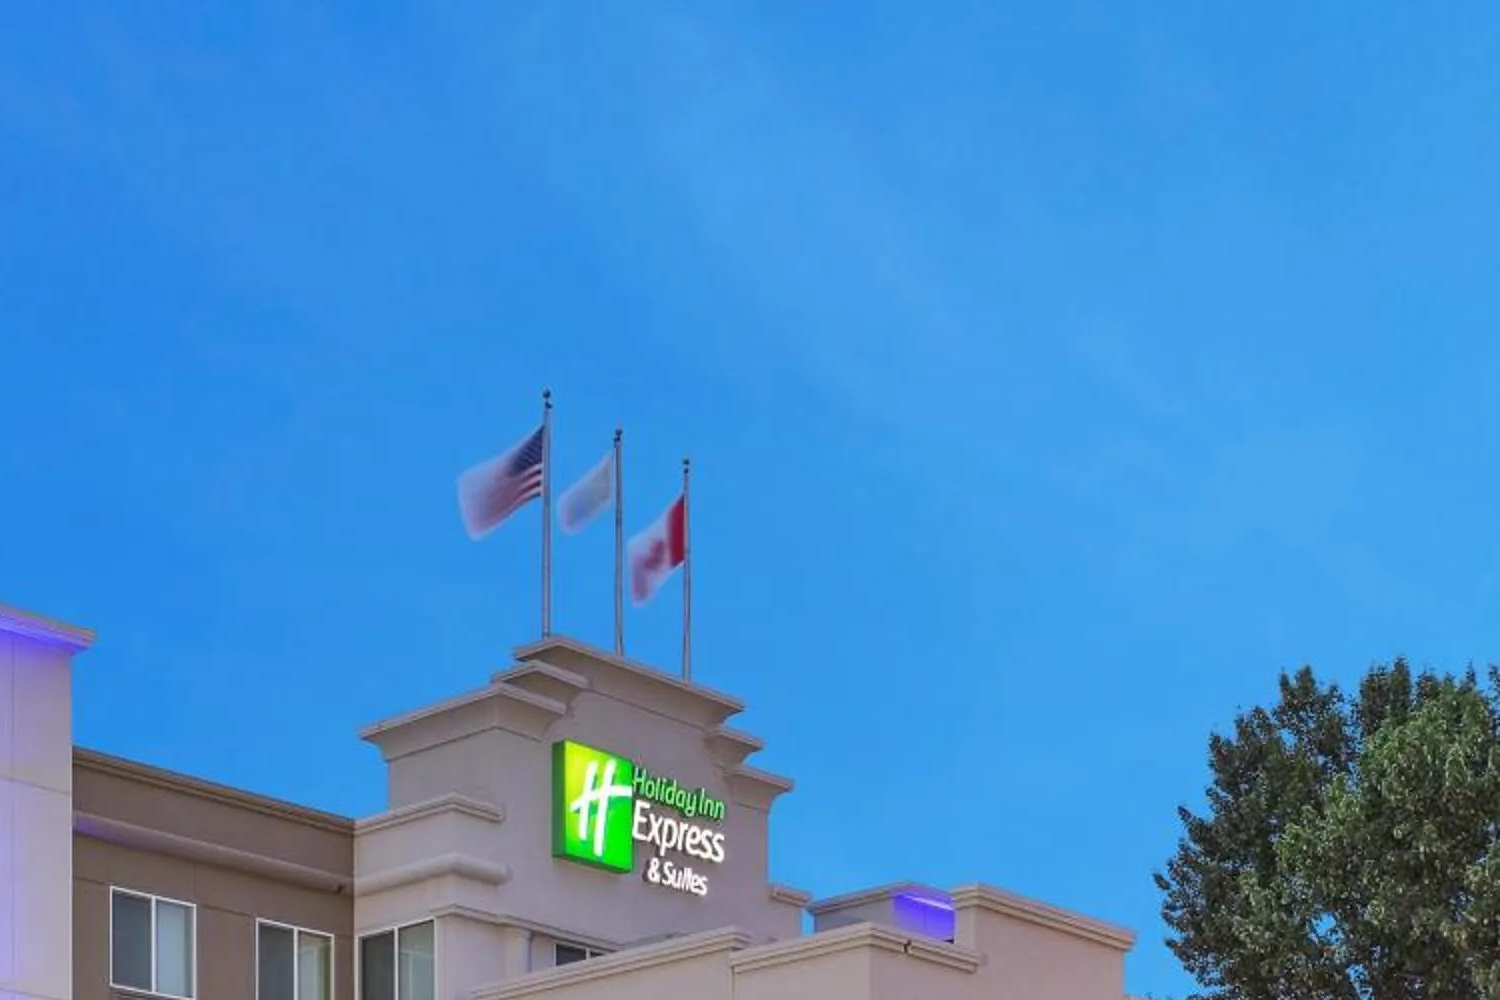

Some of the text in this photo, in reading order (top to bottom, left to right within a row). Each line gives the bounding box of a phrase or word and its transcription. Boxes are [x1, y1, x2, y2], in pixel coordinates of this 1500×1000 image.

[633, 767, 725, 820] Holiday Inn
[633, 799, 725, 864] Express
[647, 857, 708, 896] & Suites
